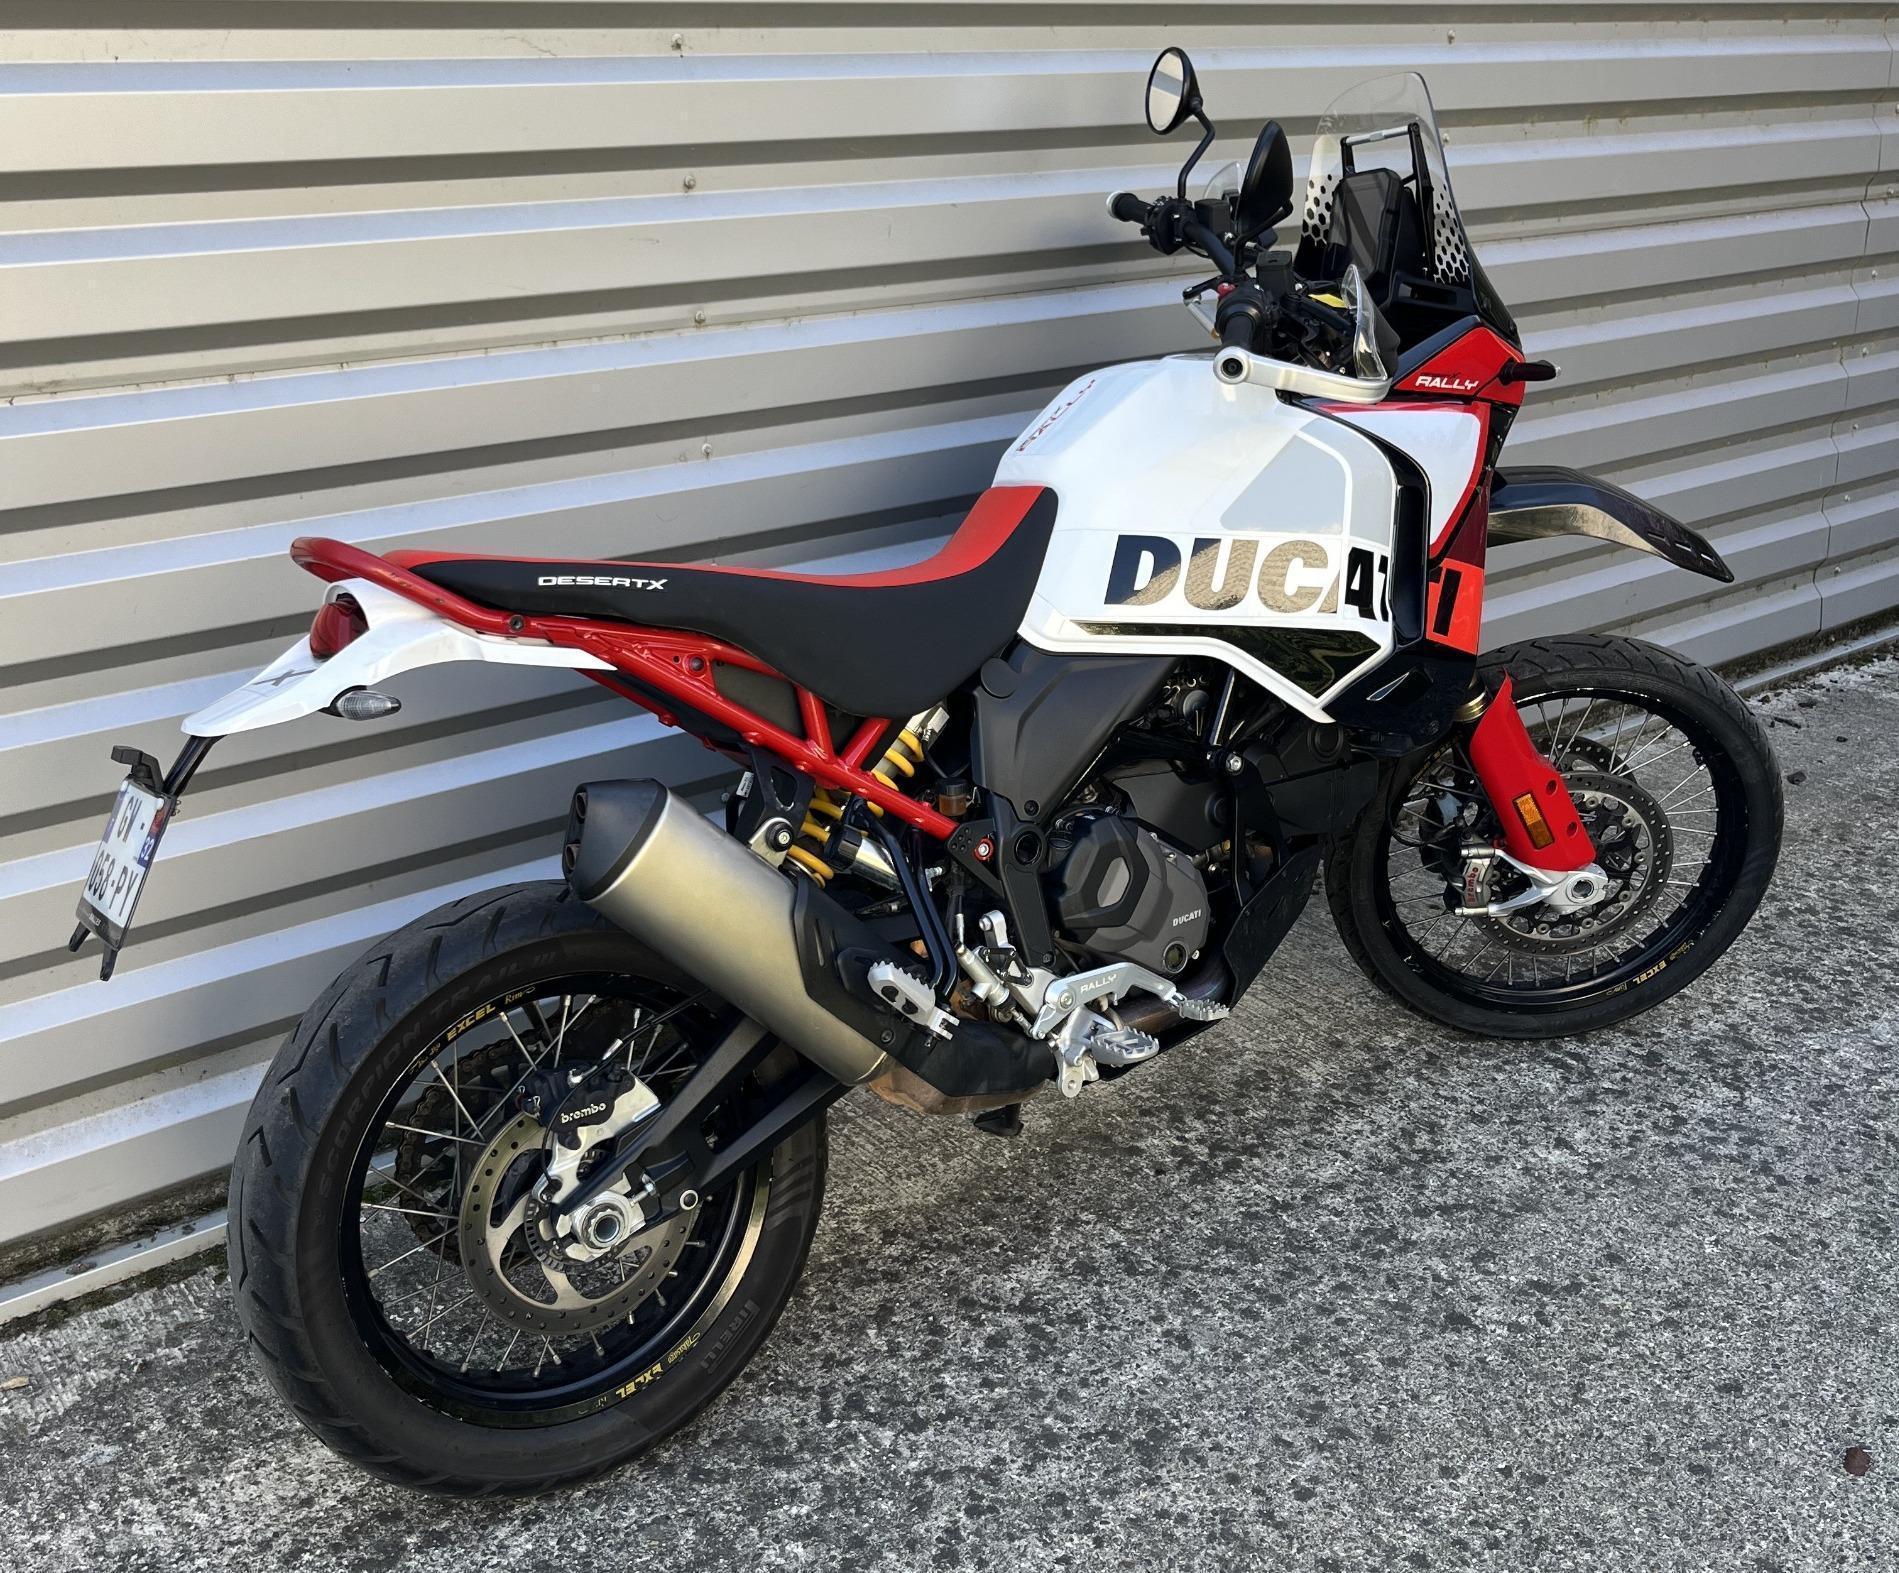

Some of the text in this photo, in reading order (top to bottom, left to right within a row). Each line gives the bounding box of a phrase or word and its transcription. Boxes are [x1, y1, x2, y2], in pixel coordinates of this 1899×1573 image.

[1415, 375, 1479, 390] RALLY
[537, 576, 669, 590] DESERTX
[1172, 908, 1202, 928] DUCATI
[1632, 959, 1668, 985] EXCEL
[1080, 973, 1119, 995] RALLY
[446, 1003, 497, 1042] EXCEL
[561, 1102, 607, 1124] brembo
[615, 1362, 664, 1399] EXCEL
